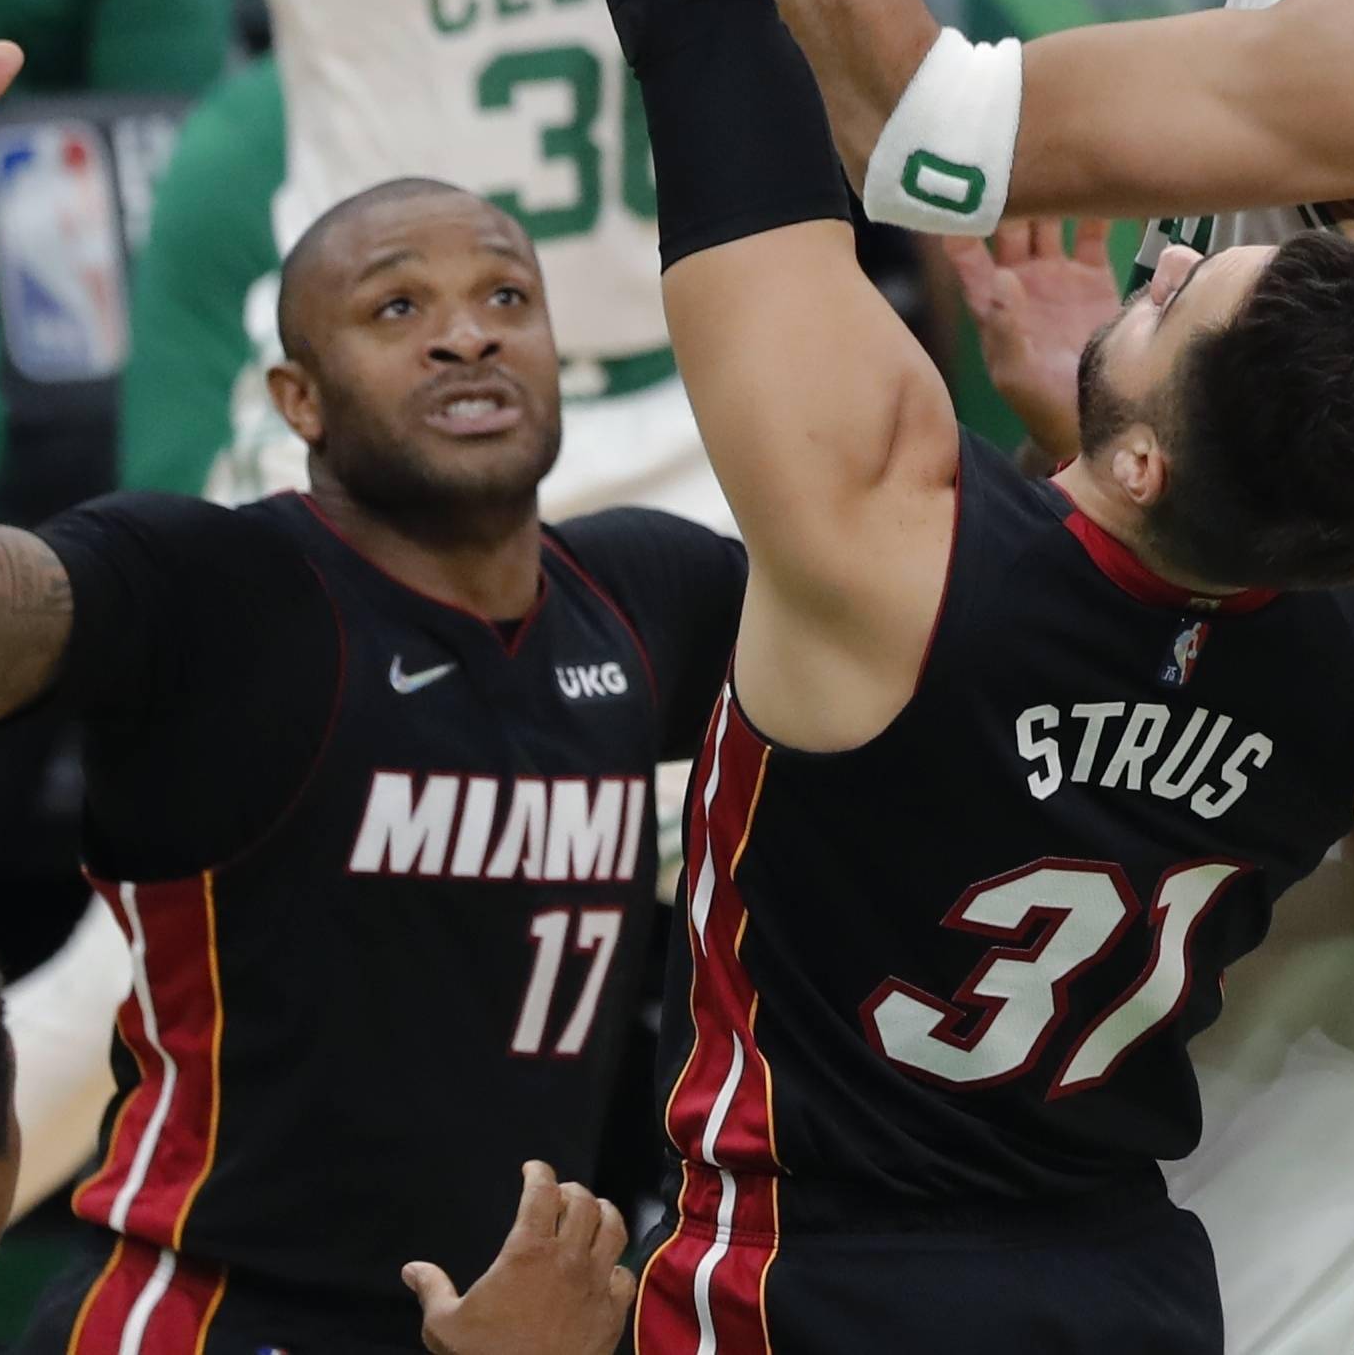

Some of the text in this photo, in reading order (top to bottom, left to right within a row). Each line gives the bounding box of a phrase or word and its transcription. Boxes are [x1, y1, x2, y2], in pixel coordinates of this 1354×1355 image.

[900, 149, 986, 214] 0
[554, 661, 628, 699] UKG
[1014, 701, 1272, 819] STRUS
[348, 770, 646, 882] MIAMI
[509, 908, 623, 1056] 17
[859, 856, 1252, 1098] 31
